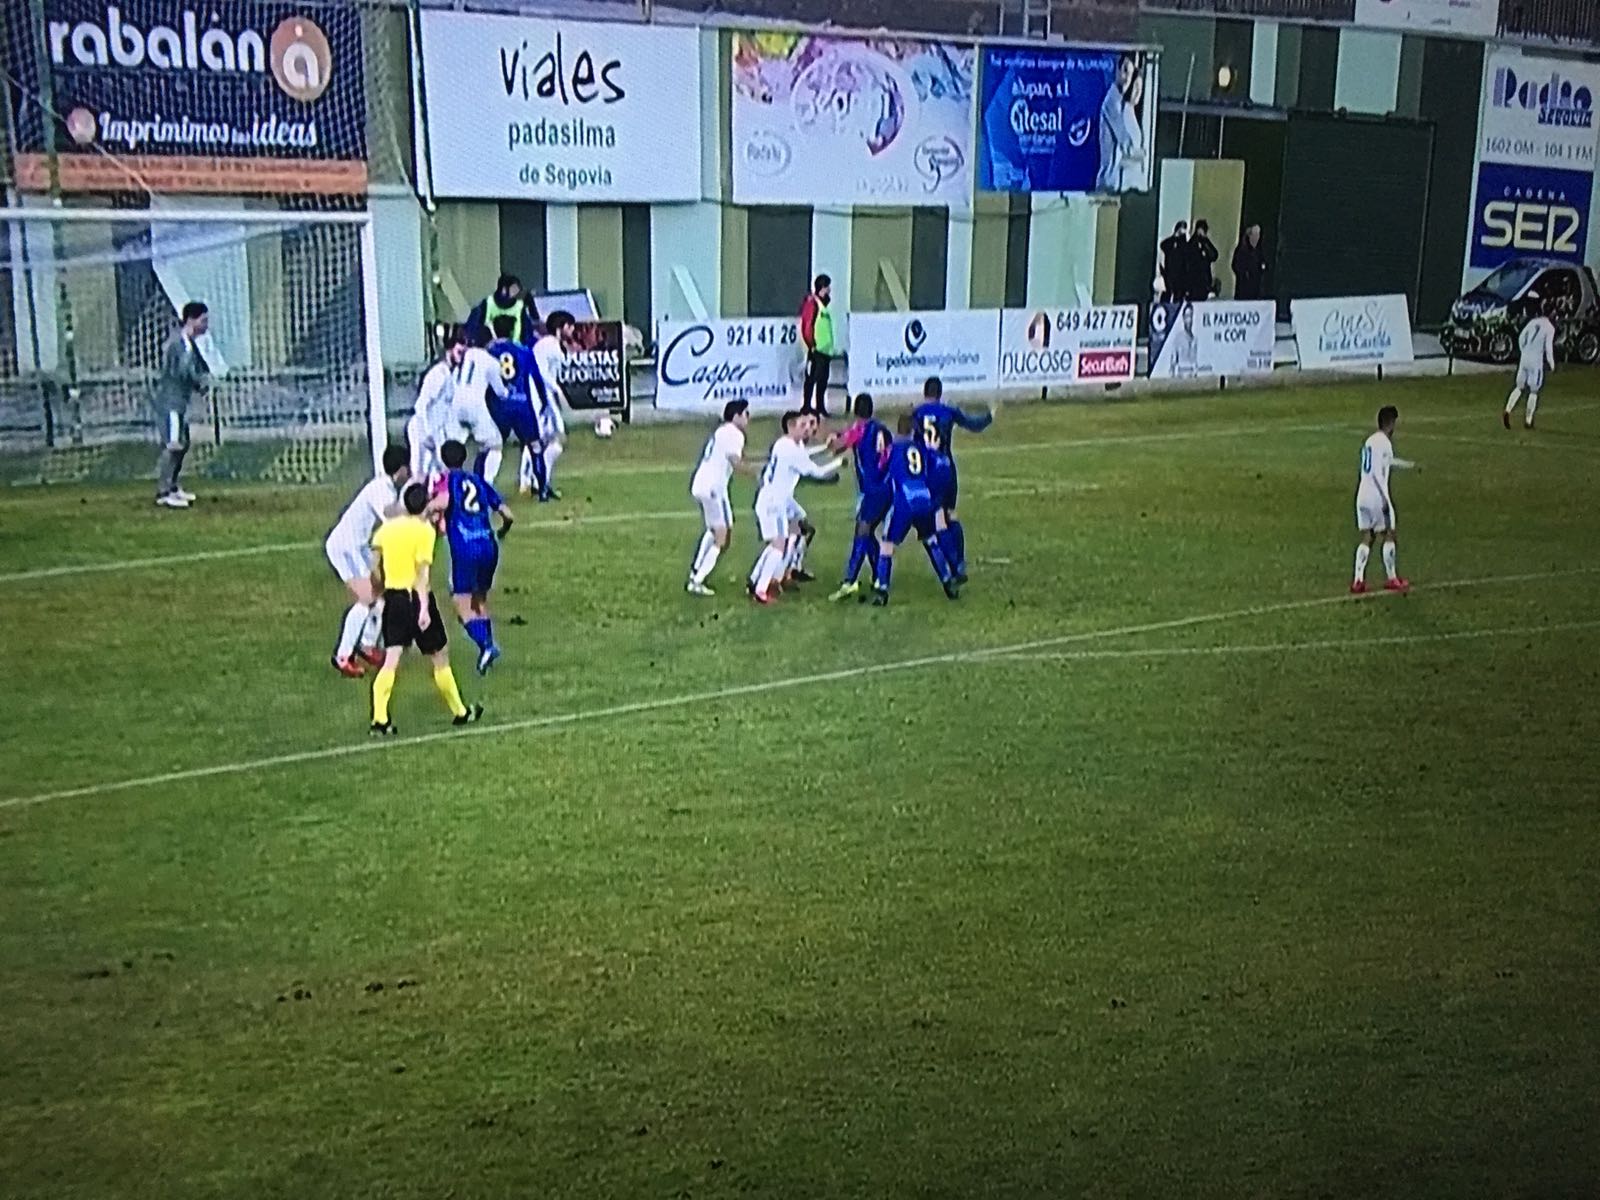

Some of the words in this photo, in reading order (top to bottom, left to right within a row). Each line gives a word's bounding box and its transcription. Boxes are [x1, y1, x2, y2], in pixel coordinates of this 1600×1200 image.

[49, 7, 265, 72] rabalán
[100, 112, 230, 149] Imprimimos
[252, 113, 318, 147] ideas
[508, 117, 616, 151] padasilma
[519, 162, 540, 184] de
[545, 163, 613, 190] Segovia
[1504, 186, 1566, 201] CADENA
[1481, 201, 1580, 253] SER
[1056, 311, 1080, 332] 649
[1083, 310, 1107, 331] 427
[1202, 312, 1212, 328] EL
[727, 325, 752, 346] 921
[758, 325, 775, 345] 41
[781, 324, 797, 344] 26
[500, 352, 516, 380] 8
[1002, 349, 1073, 374] nucose
[462, 479, 481, 513] 2
